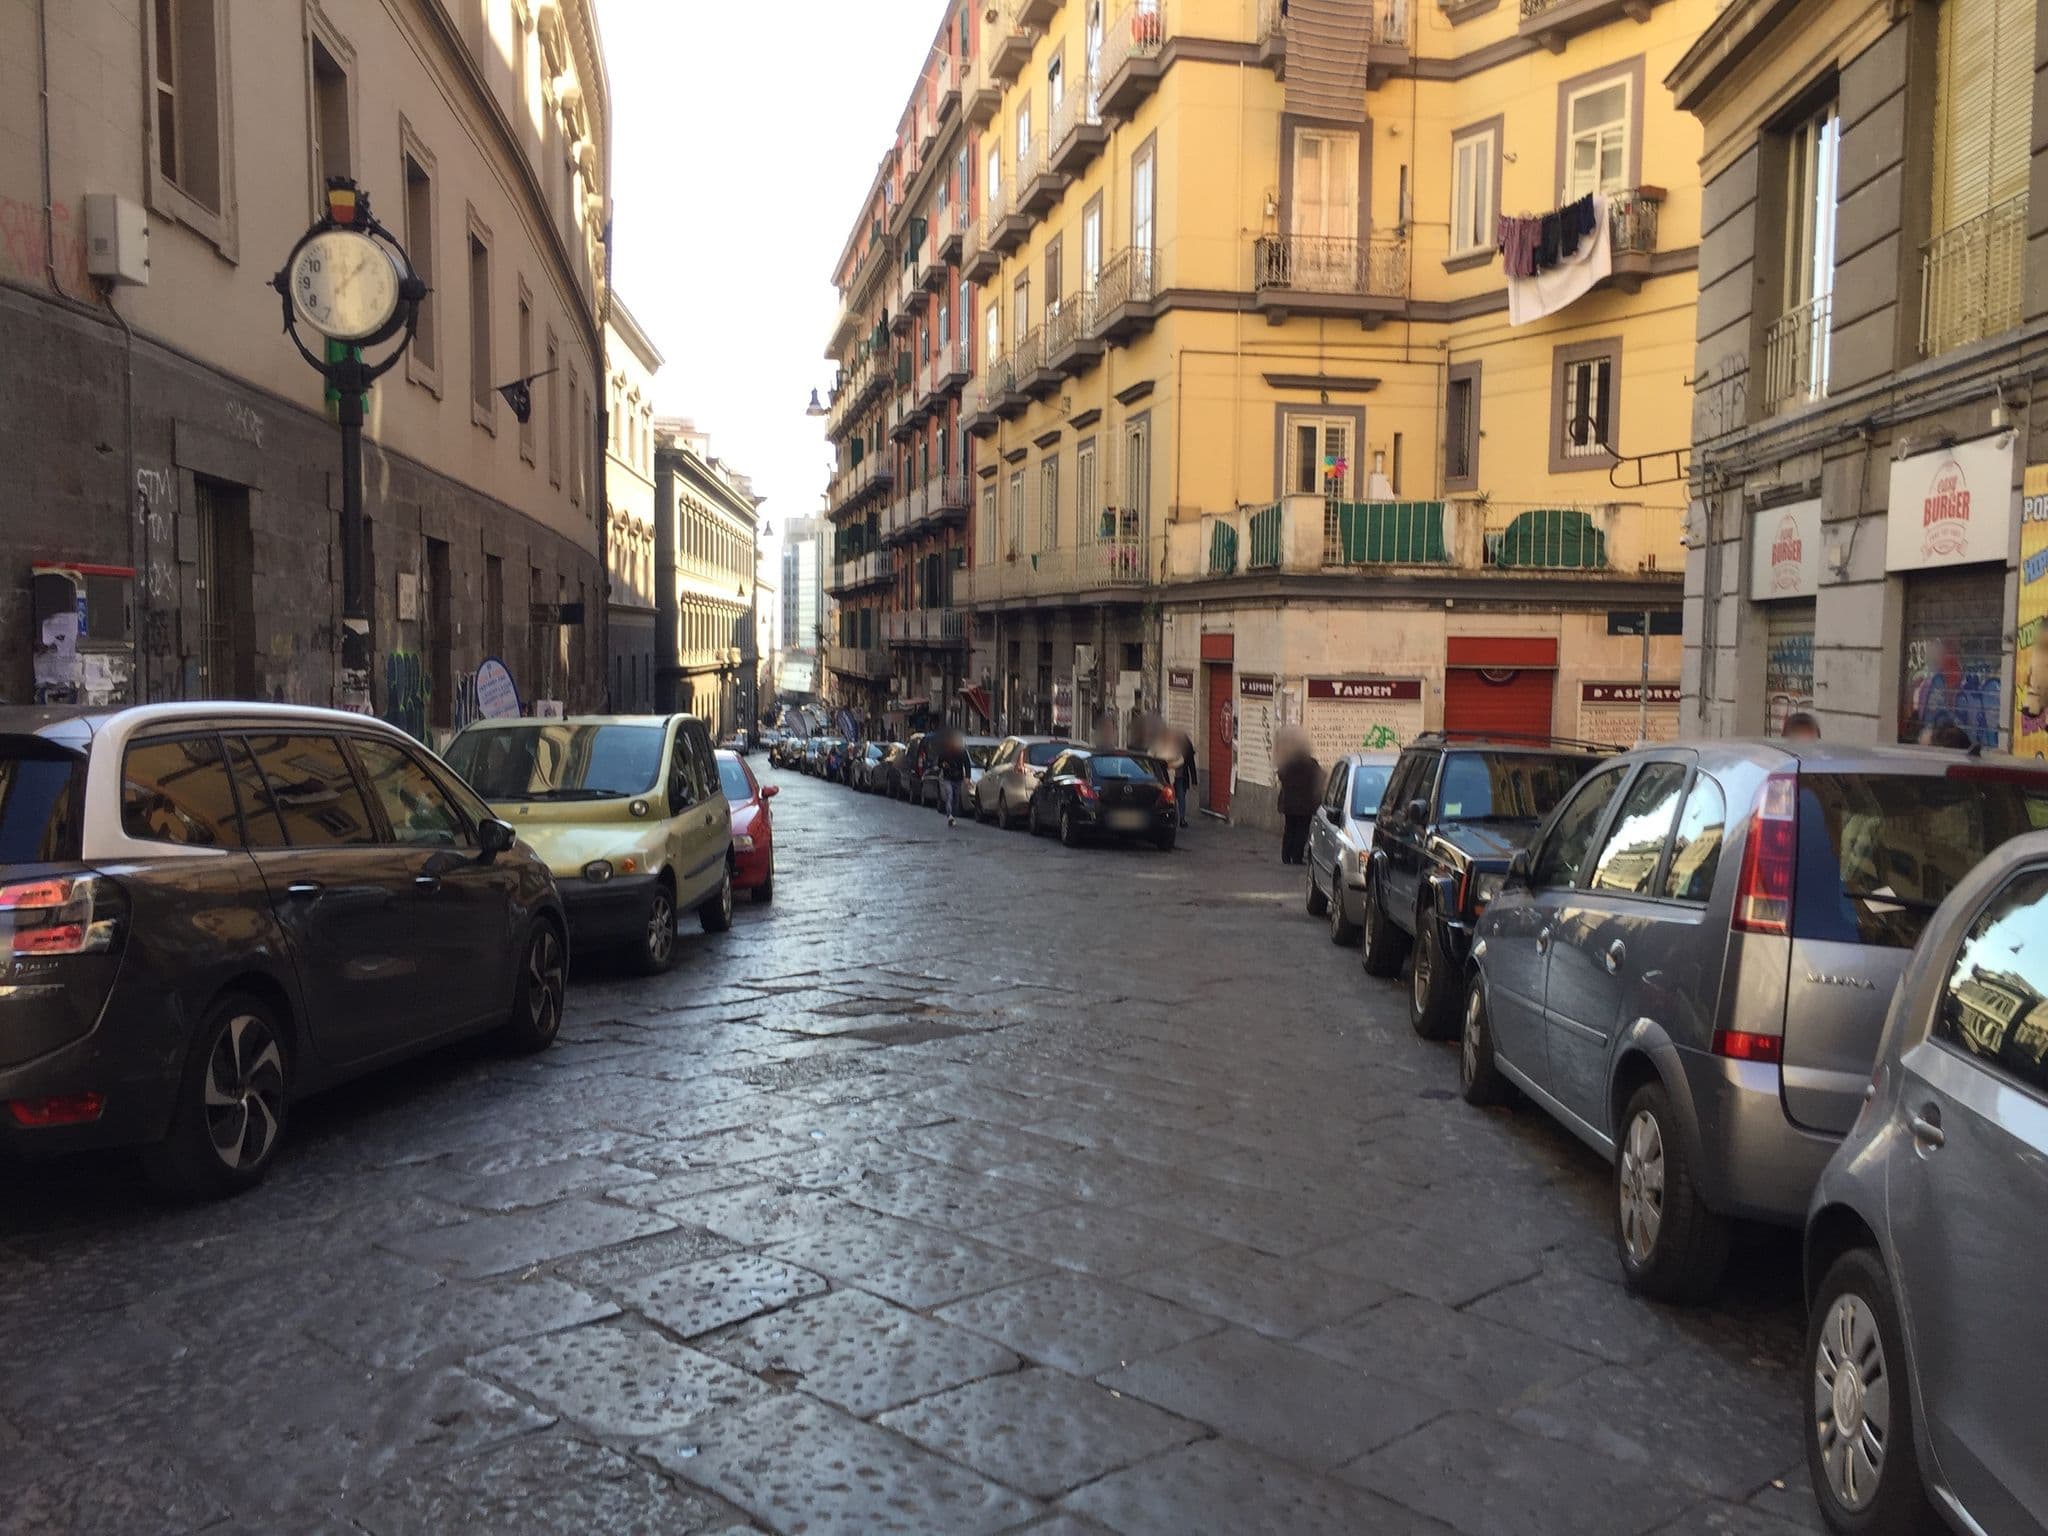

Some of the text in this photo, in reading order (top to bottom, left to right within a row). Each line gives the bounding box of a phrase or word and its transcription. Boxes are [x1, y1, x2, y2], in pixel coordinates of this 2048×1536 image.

[309, 260, 321, 273] 10
[303, 276, 311, 290] 9
[309, 294, 317, 308] 8
[1923, 491, 1970, 528] BURGER
[1772, 539, 1802, 568] BURGER
[1332, 682, 1392, 697] TANDEM
[1594, 689, 1609, 698] D'
